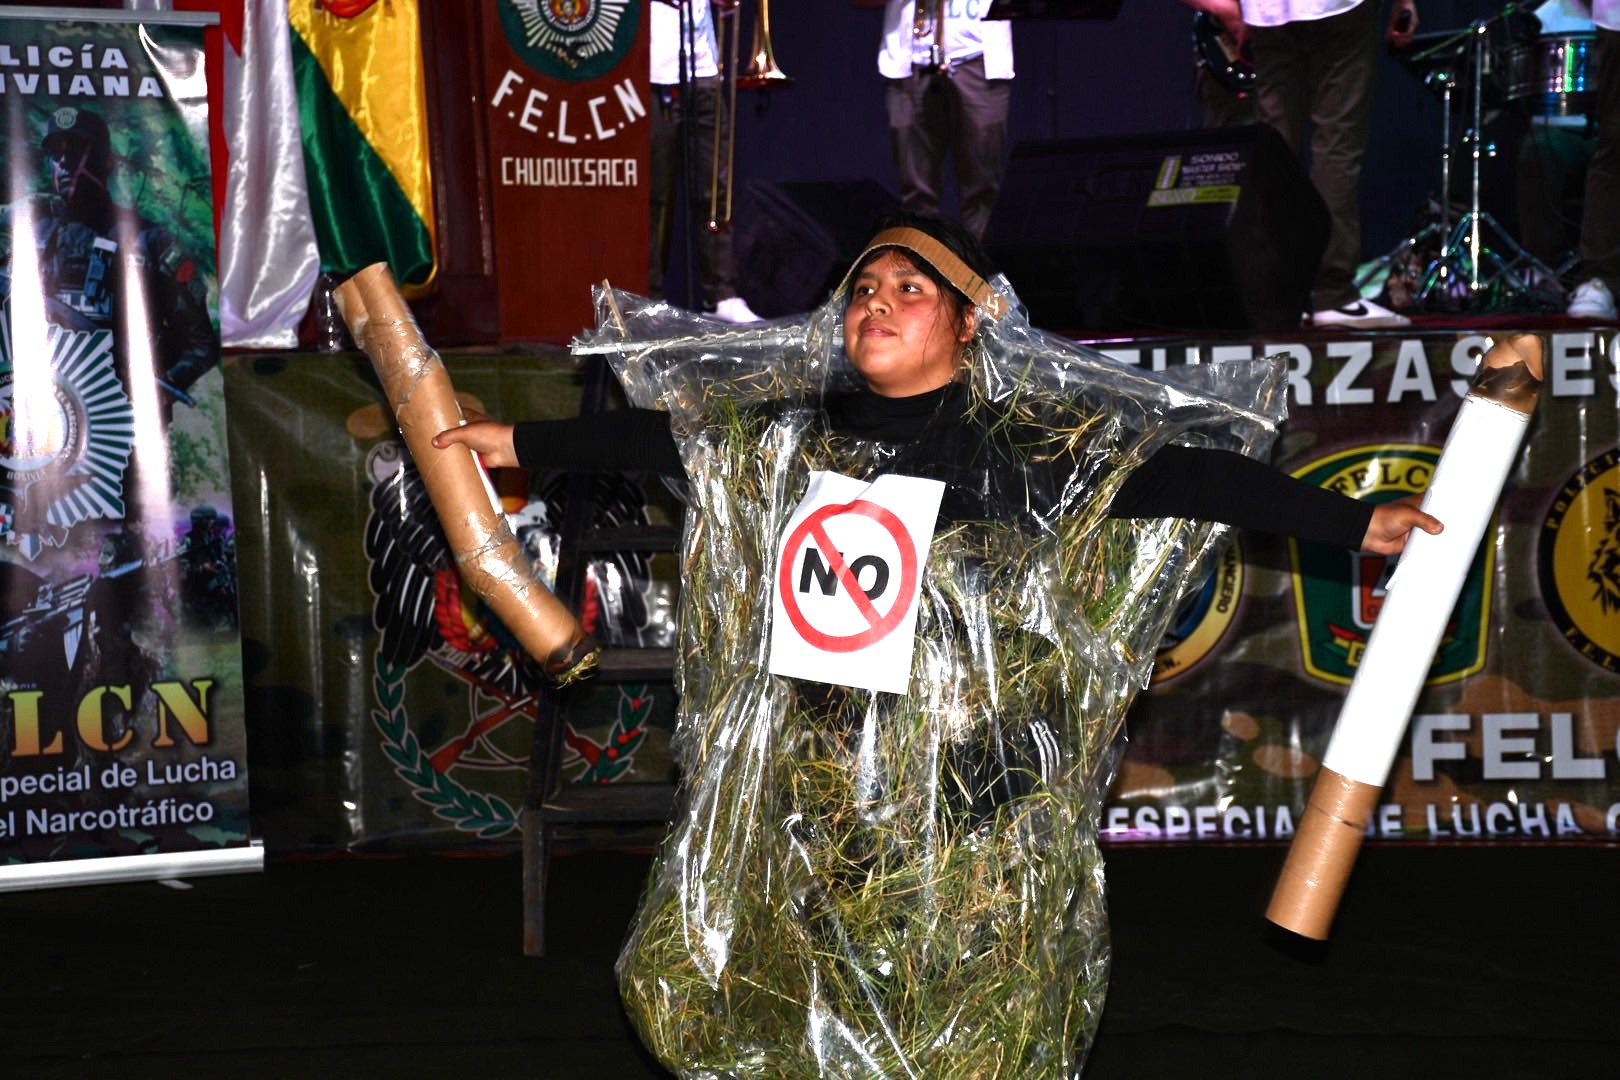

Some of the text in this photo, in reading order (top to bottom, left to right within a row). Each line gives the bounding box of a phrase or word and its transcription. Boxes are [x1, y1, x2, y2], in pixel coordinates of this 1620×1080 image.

[491, 69, 647, 144] F.E.L.C.N
[502, 157, 638, 187] CHUQUISACA
[1098, 332, 1620, 406] RZAS E
[1329, 463, 1430, 492] FELC
[799, 547, 890, 601] NO
[8, 680, 214, 757] LCN
[1412, 712, 1620, 780] FEL
[101, 762, 138, 788] de
[147, 756, 236, 785] Lucha
[26, 798, 214, 835] Narcotráfico
[1107, 805, 1296, 838] ESPECIA
[1426, 802, 1584, 836] LUCHA
